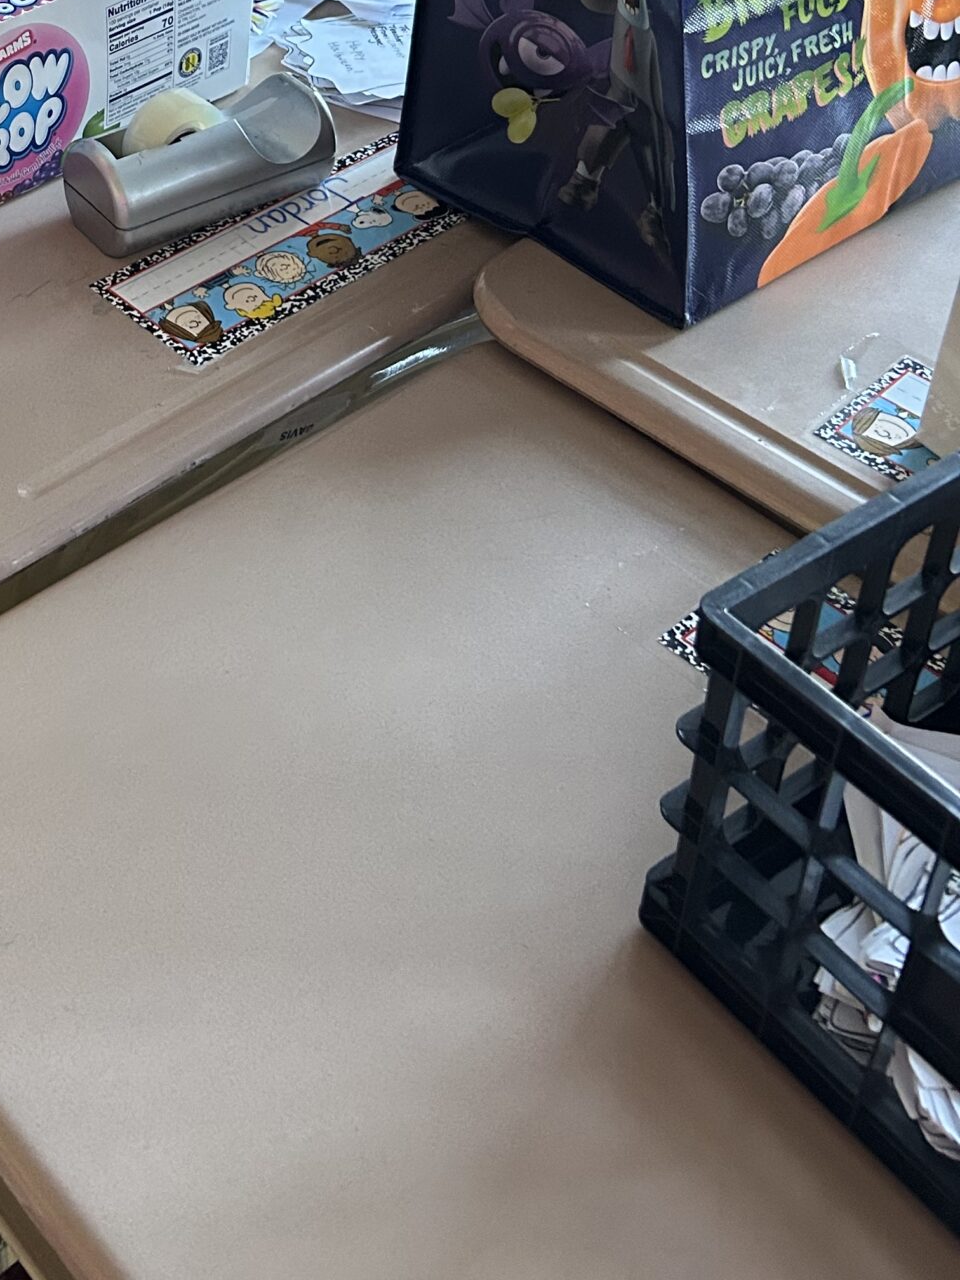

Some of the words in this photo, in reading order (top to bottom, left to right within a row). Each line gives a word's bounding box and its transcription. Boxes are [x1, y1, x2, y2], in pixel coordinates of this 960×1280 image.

[109, 34, 139, 52] Calories
[161, 15, 174, 28] 70
[700, 32, 780, 79] CRISPY,
[732, 51, 792, 92] JUICY,
[791, 20, 854, 64] FRESH
[719, 33, 868, 149] GRAPES!
[242, 176, 366, 234] Jordan
